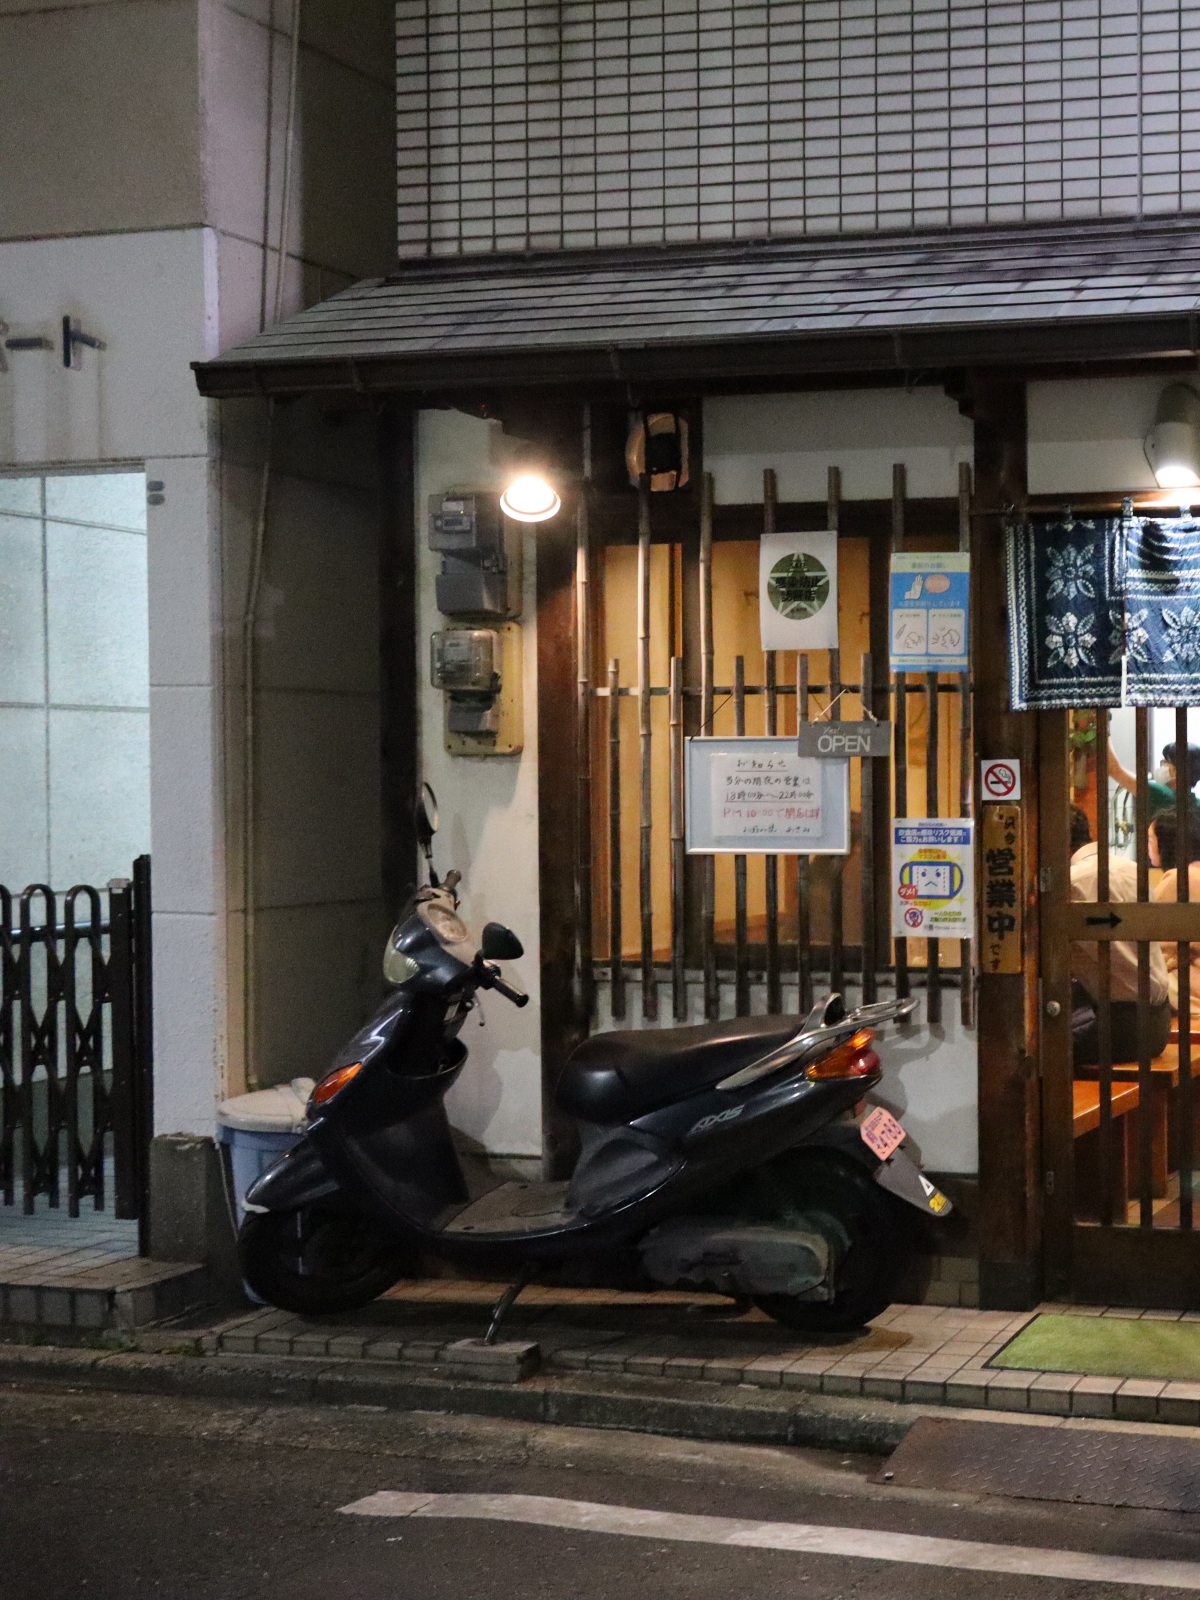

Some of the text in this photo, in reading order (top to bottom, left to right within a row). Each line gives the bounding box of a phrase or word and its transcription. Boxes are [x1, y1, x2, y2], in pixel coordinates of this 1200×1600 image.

[817, 735, 871, 753] OPEN
[736, 759, 787, 769] お知らせ
